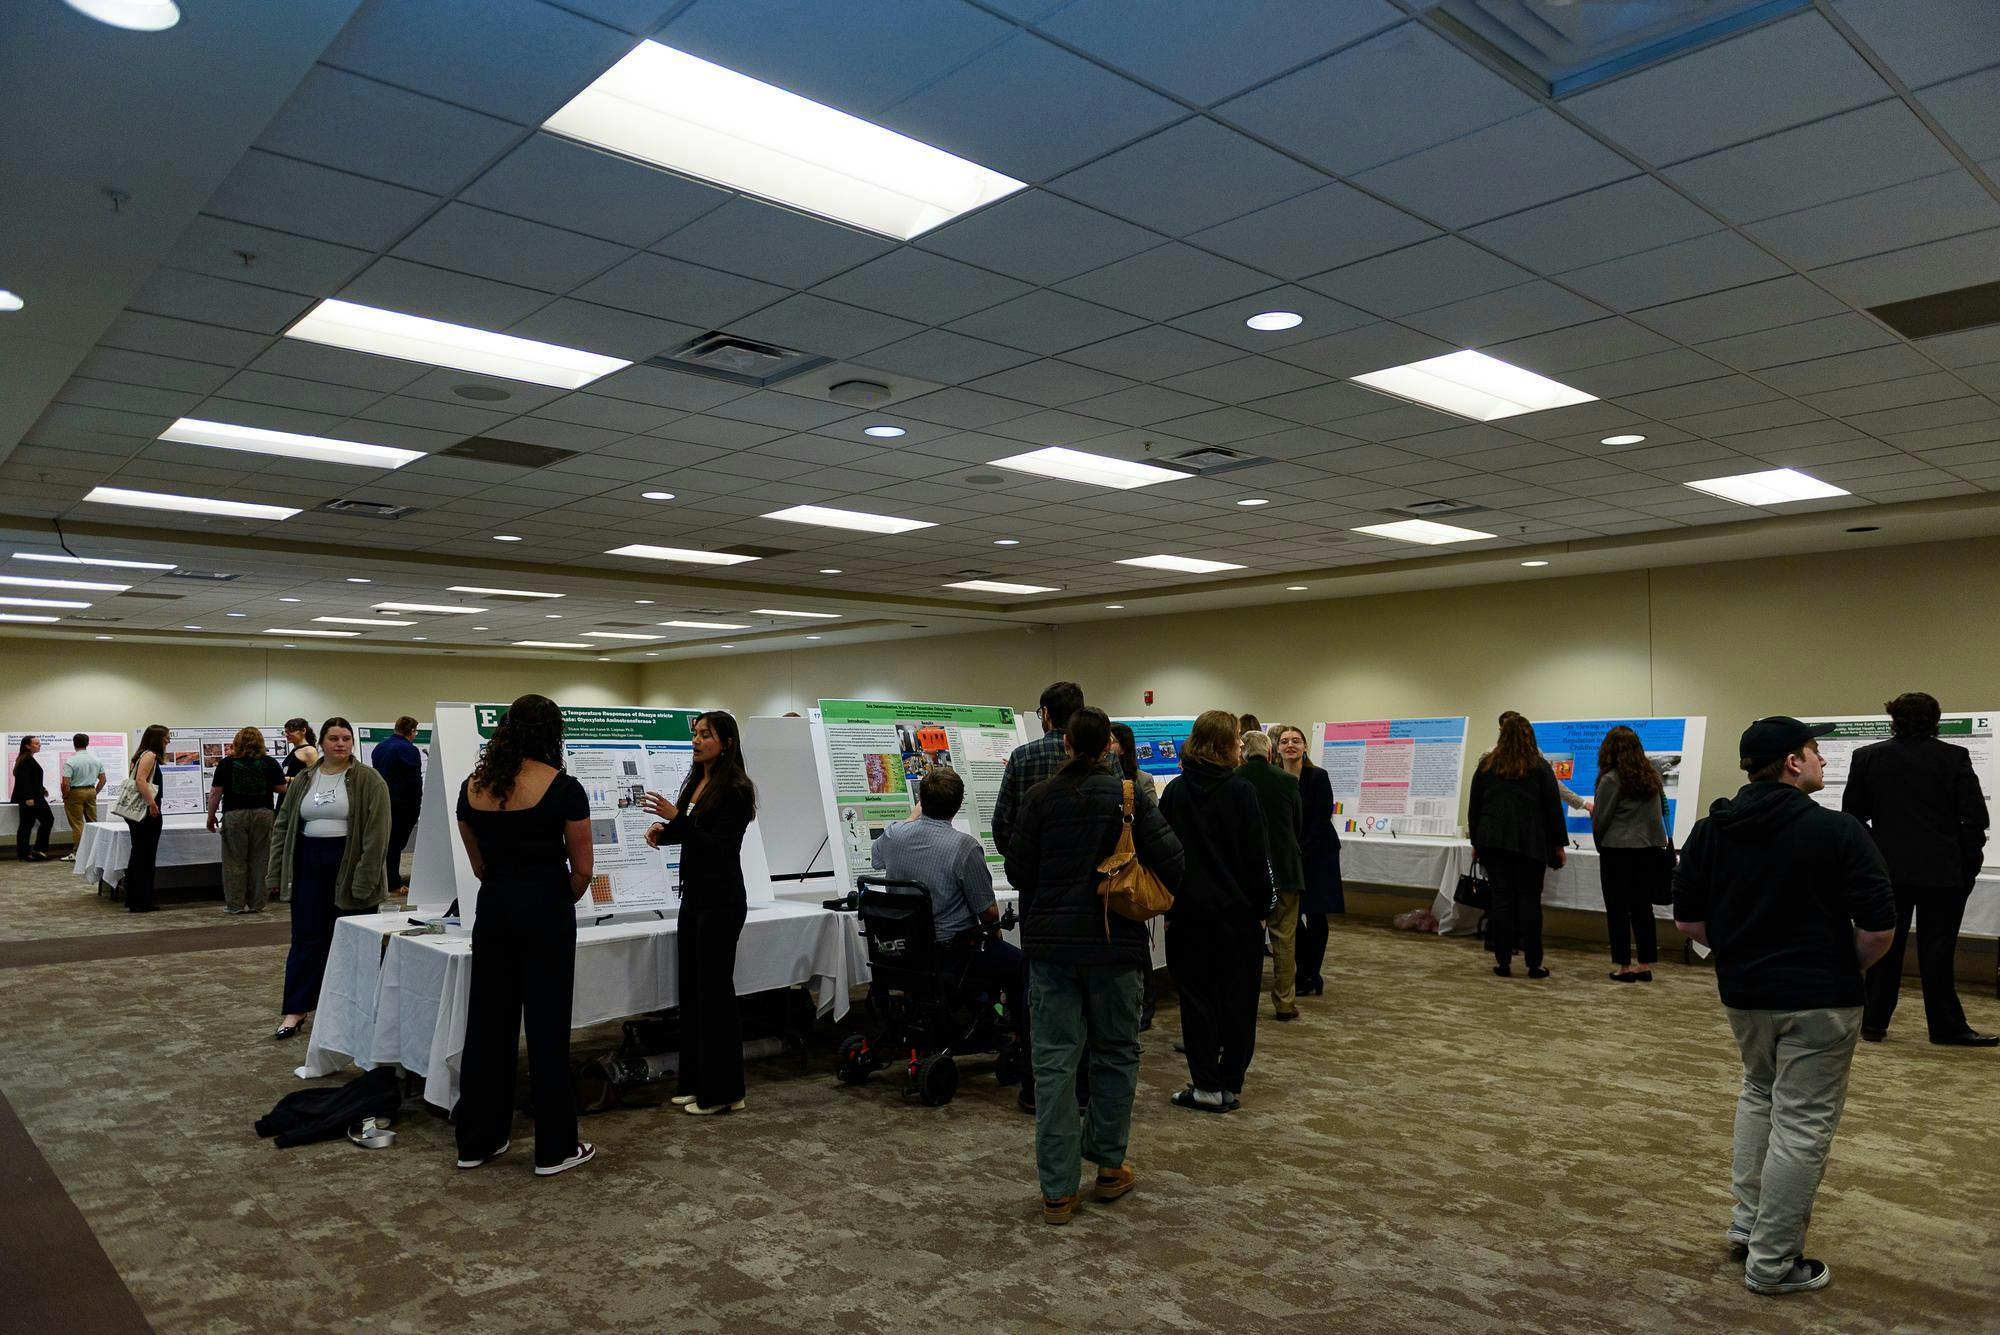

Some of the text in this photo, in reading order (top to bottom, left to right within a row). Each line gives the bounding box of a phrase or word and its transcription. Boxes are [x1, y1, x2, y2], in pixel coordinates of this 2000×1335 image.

[480, 709, 499, 728] E
[977, 718, 988, 728] E
[1576, 722, 1600, 731] Viewing
